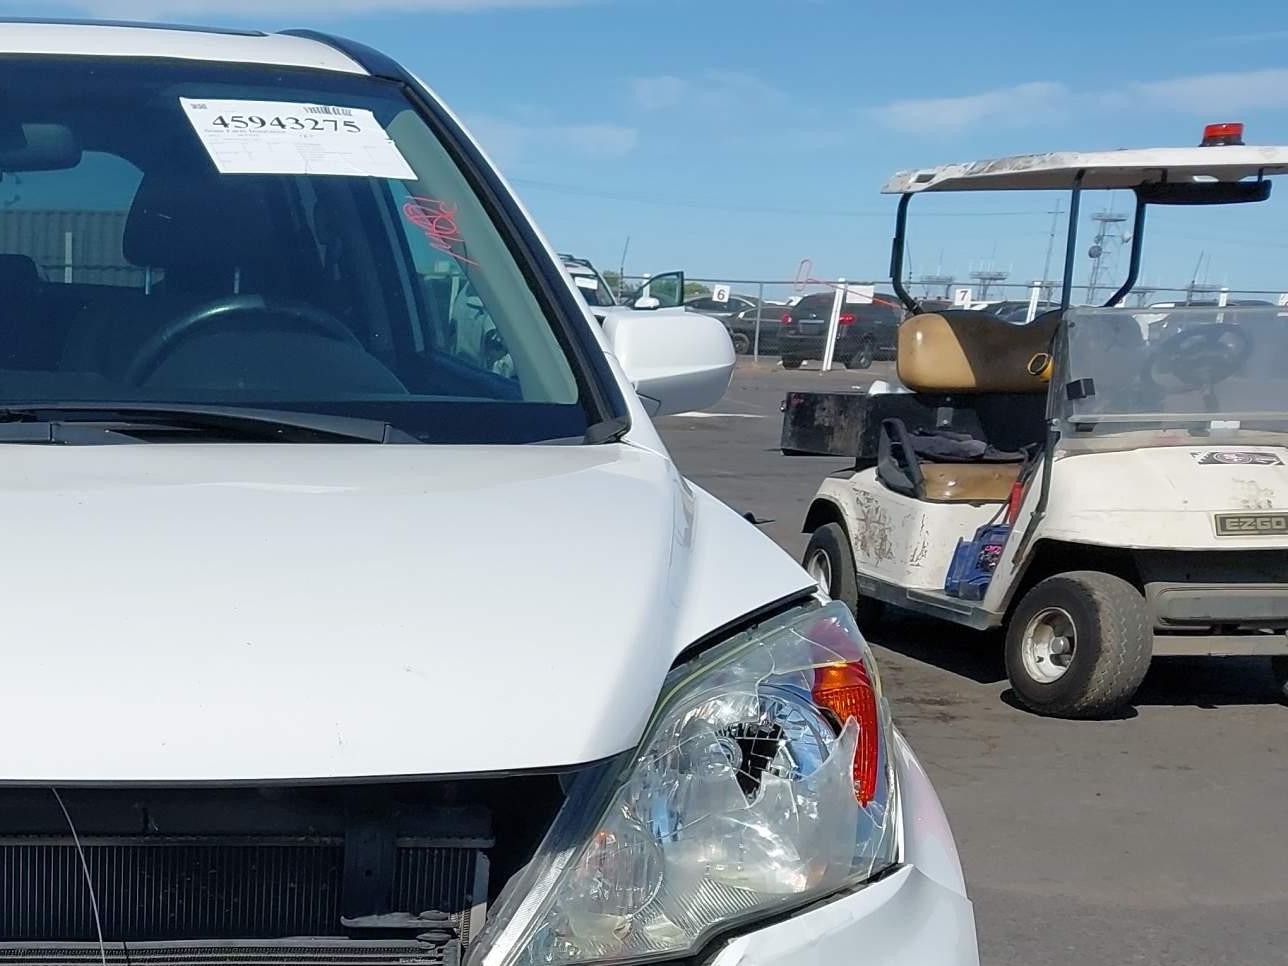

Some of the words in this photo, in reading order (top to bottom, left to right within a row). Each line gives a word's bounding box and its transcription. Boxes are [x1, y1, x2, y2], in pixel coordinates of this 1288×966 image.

[212, 115, 361, 133] 45943275
[716, 288, 726, 301] 6
[959, 290, 969, 301] 7
[1225, 516, 1287, 531] EZGO
